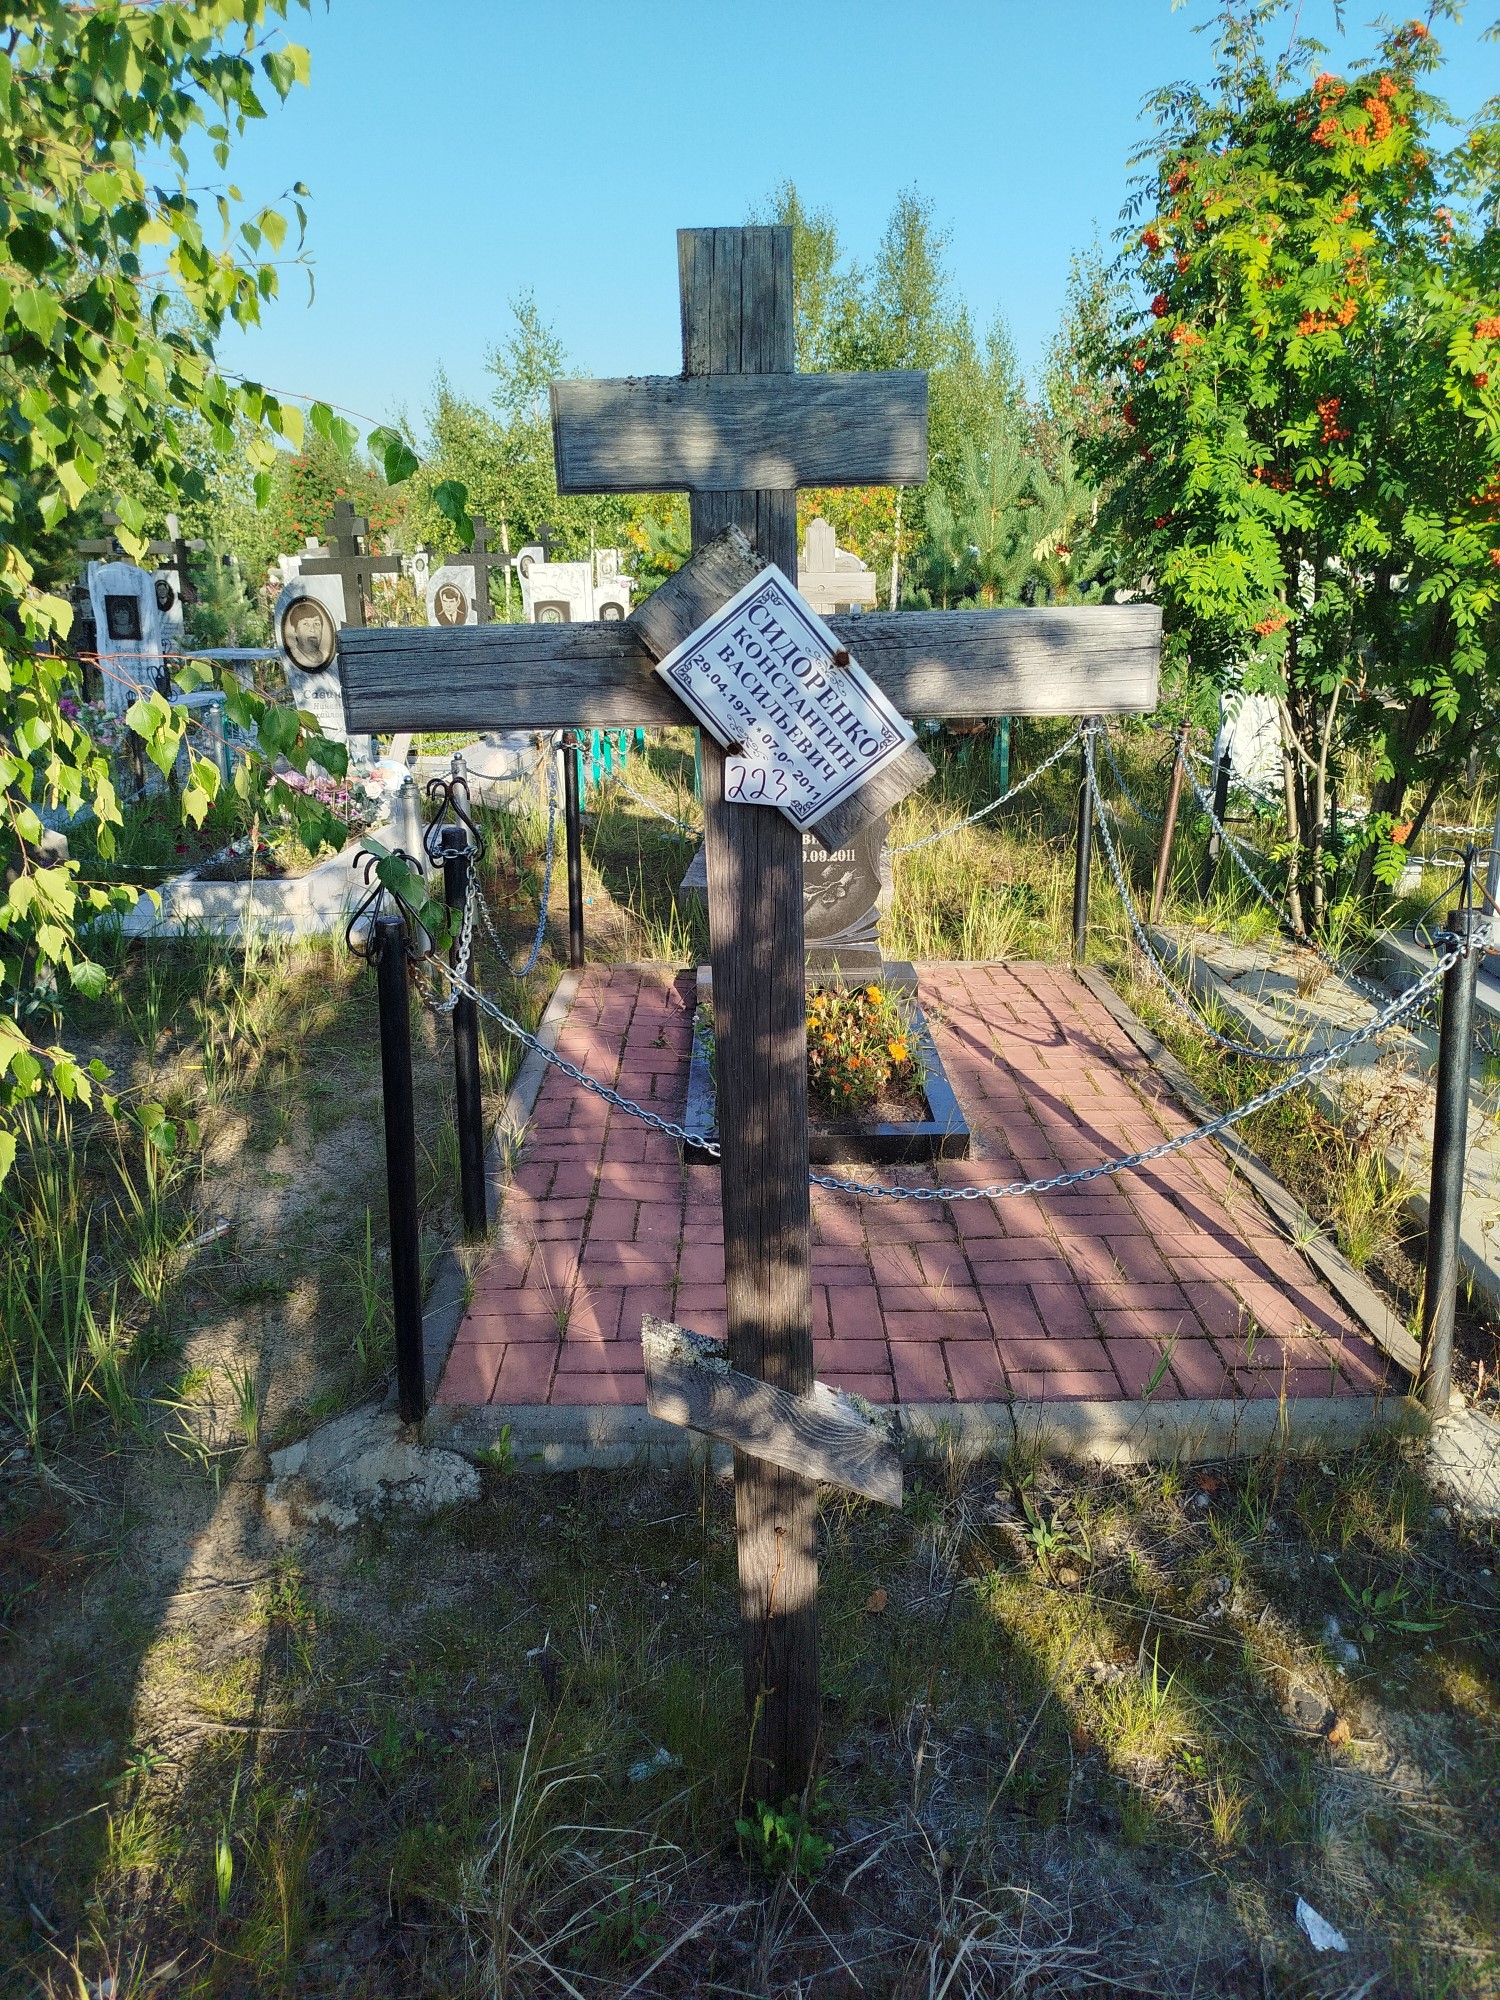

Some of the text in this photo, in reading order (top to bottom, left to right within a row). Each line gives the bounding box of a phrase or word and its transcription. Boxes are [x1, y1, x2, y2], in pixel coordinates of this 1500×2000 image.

[692, 654, 822, 801] 29.04.1974 07.02011
[715, 643, 838, 783] ВАСИЛЬЕВИЧ
[731, 625, 858, 772] КОНСТАНТИН
[747, 604, 879, 758] СИДОРЕНКО
[728, 765, 788, 802] 223
